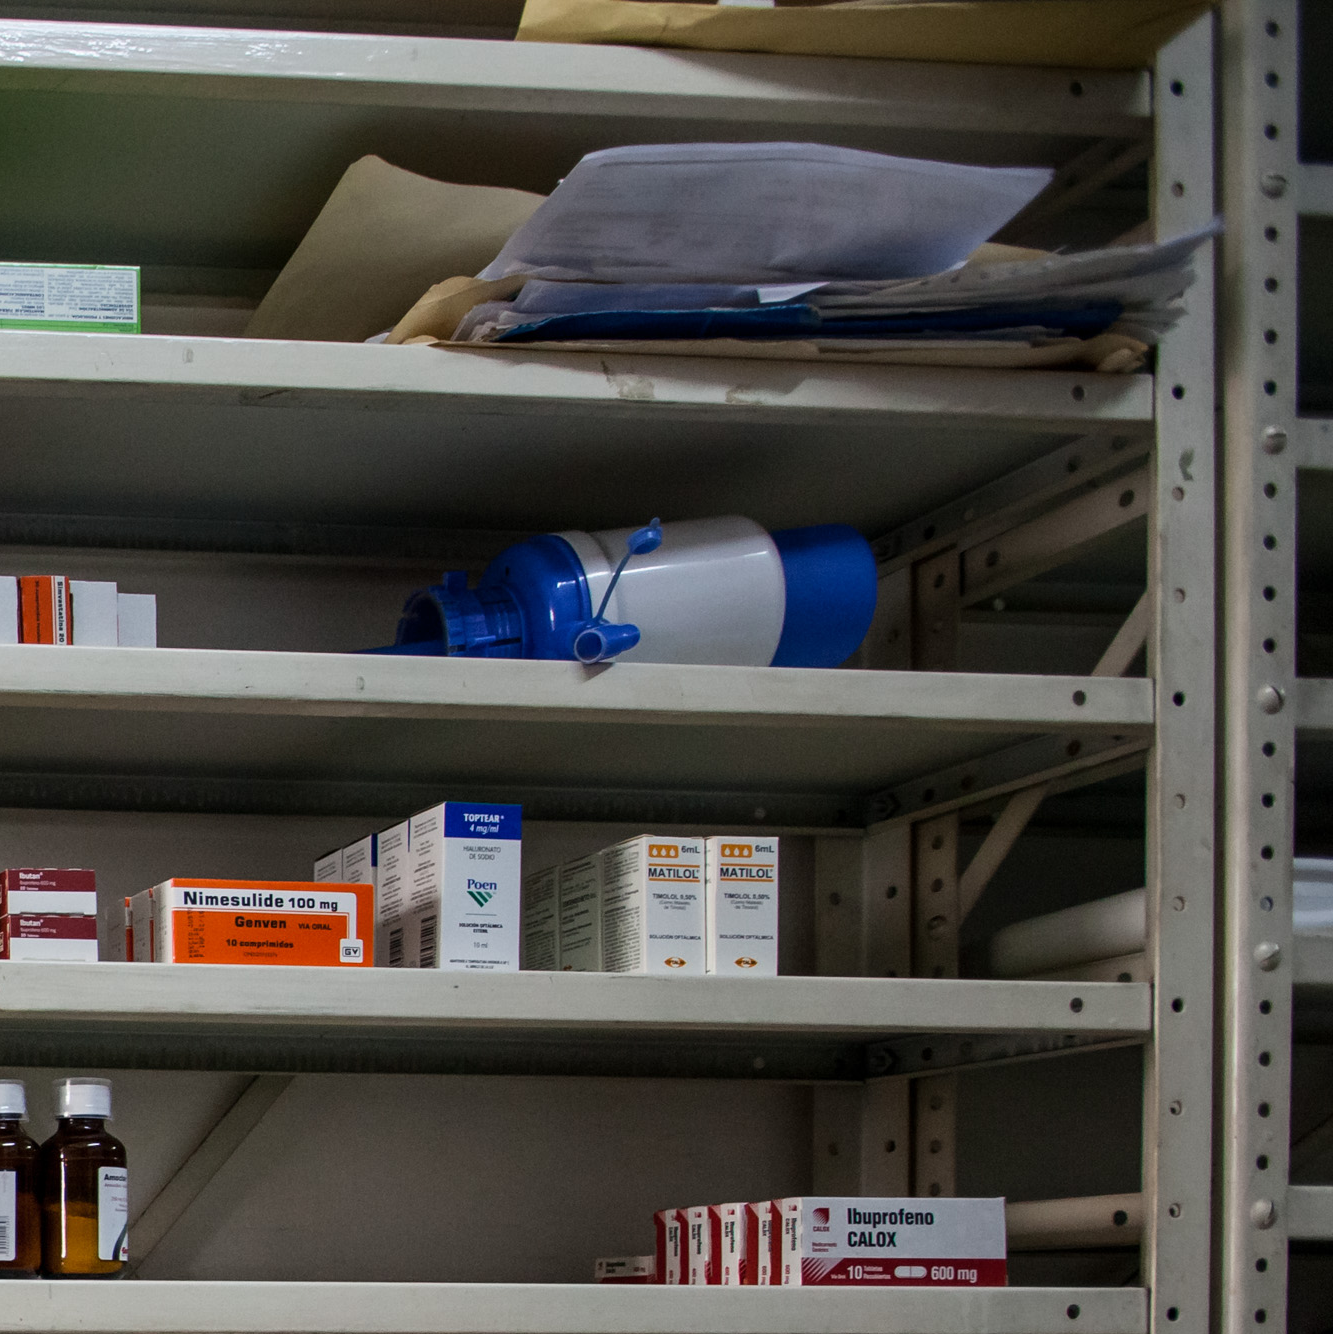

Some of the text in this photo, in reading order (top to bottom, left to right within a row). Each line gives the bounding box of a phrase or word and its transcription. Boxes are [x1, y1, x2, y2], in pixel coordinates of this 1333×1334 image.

[464, 813, 500, 823] TOPTEAR
[476, 825, 499, 835] mg/ml
[648, 868, 698, 878] MATILOL
[720, 868, 772, 878] MATILOL
[467, 879, 497, 890] Poen
[183, 891, 338, 912] Nimesulide 100 mg
[235, 916, 287, 929] Genven
[226, 939, 294, 949] 10 comprimidos
[847, 1208, 934, 1228] Ibuprofeno
[847, 1231, 896, 1247] CALOX
[847, 1266, 977, 1283] 10 600 mg
